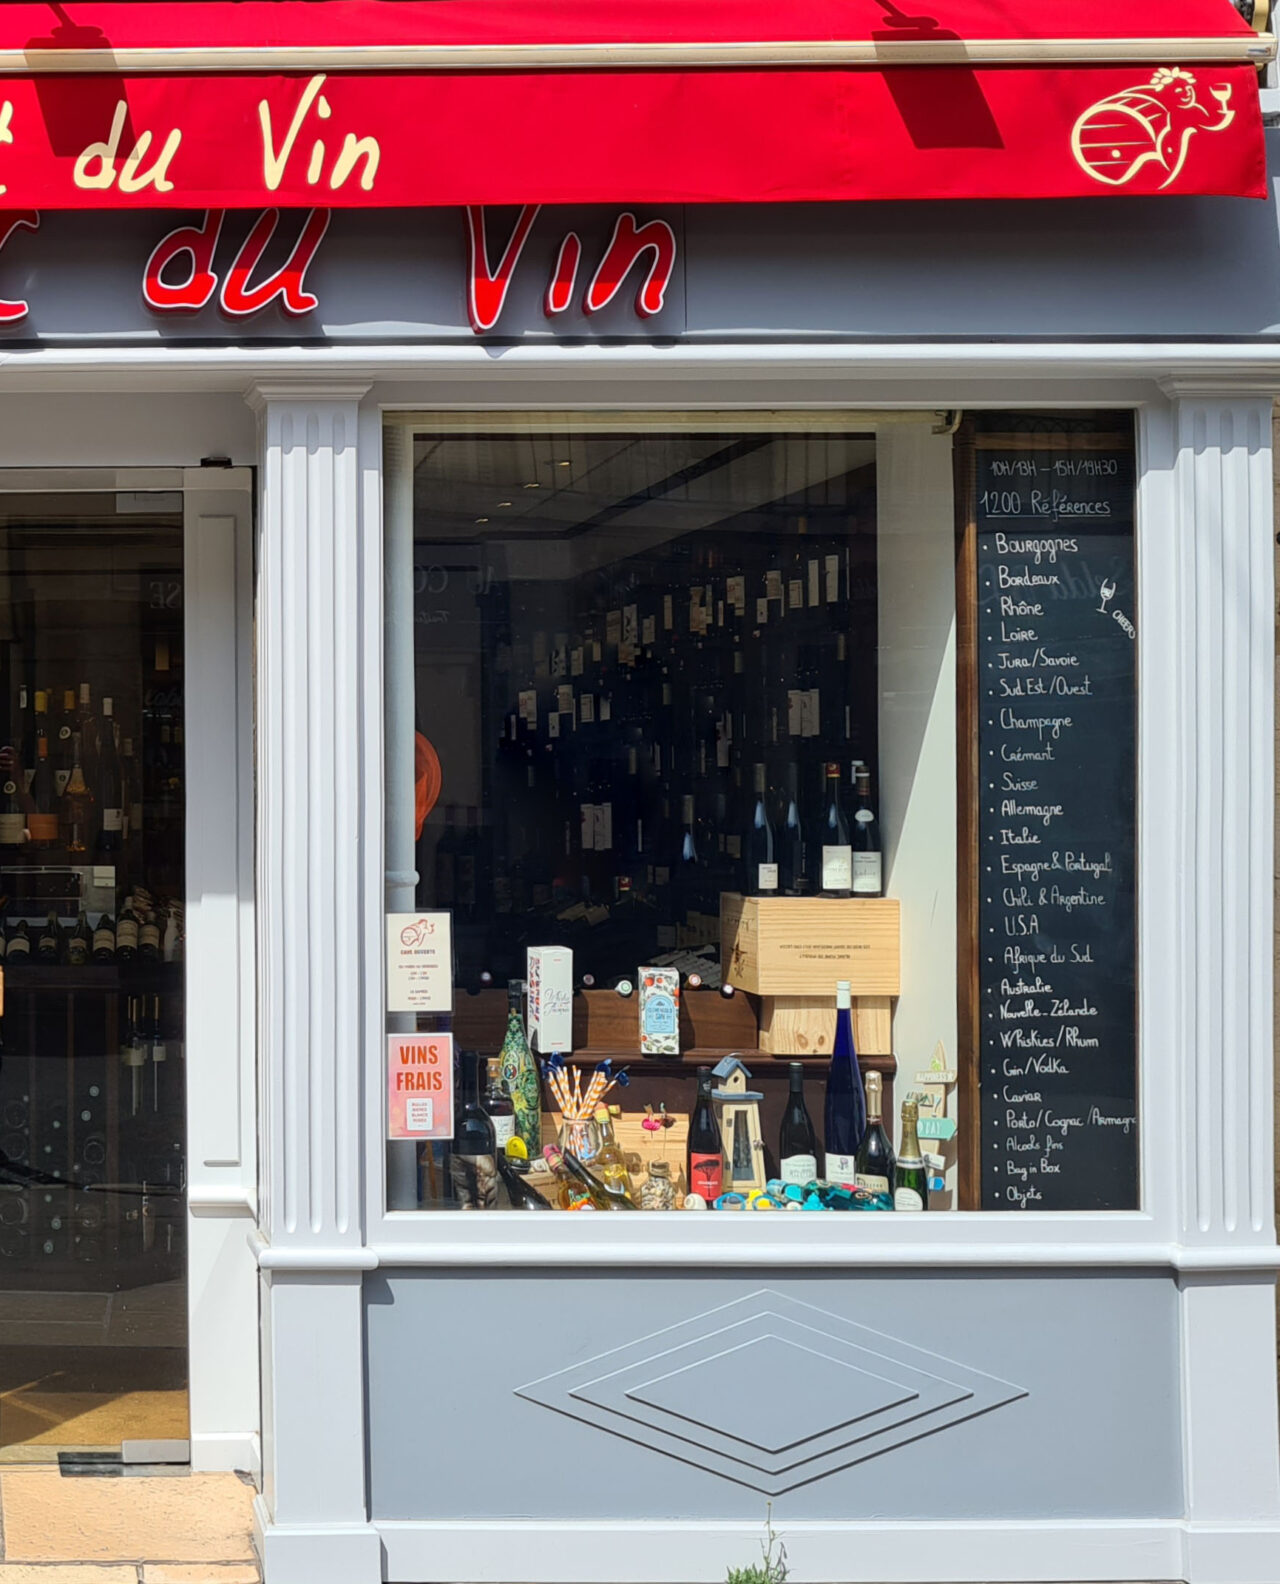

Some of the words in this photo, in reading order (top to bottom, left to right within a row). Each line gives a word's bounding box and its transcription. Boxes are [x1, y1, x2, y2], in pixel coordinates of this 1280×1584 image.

[73, 100, 181, 192] du
[259, 74, 381, 191] Vin
[142, 207, 331, 317] du
[466, 204, 676, 331] Vin
[980, 491, 1021, 514] 1200
[996, 532, 1078, 564] Bourgognes
[998, 565, 1060, 589] Bordeaux
[1000, 596, 1044, 616] Rhône
[1001, 622, 1038, 642] Loire
[1000, 708, 1073, 741] Champagne
[1001, 742, 1055, 761] Crémant
[1001, 772, 1039, 791] Suisse
[1001, 799, 1063, 826] Allemagne
[1000, 827, 1041, 845] Italie
[1001, 855, 1051, 881] Espagne
[1065, 852, 1113, 879] Portugal
[1003, 886, 1034, 907] Chili
[1051, 885, 1106, 912] Argentine
[1004, 946, 1046, 974] Afrique
[1050, 945, 1066, 964] du
[1070, 943, 1094, 963] Sud
[1001, 976, 1053, 995] Australie
[400, 1045, 439, 1065] VINS
[396, 1071, 443, 1091] FRAIS
[1003, 1085, 1042, 1102] Caviar
[1007, 1160, 1027, 1181] Bag
[1040, 1158, 1061, 1173] Box
[1007, 1185, 1042, 1208] Objets
